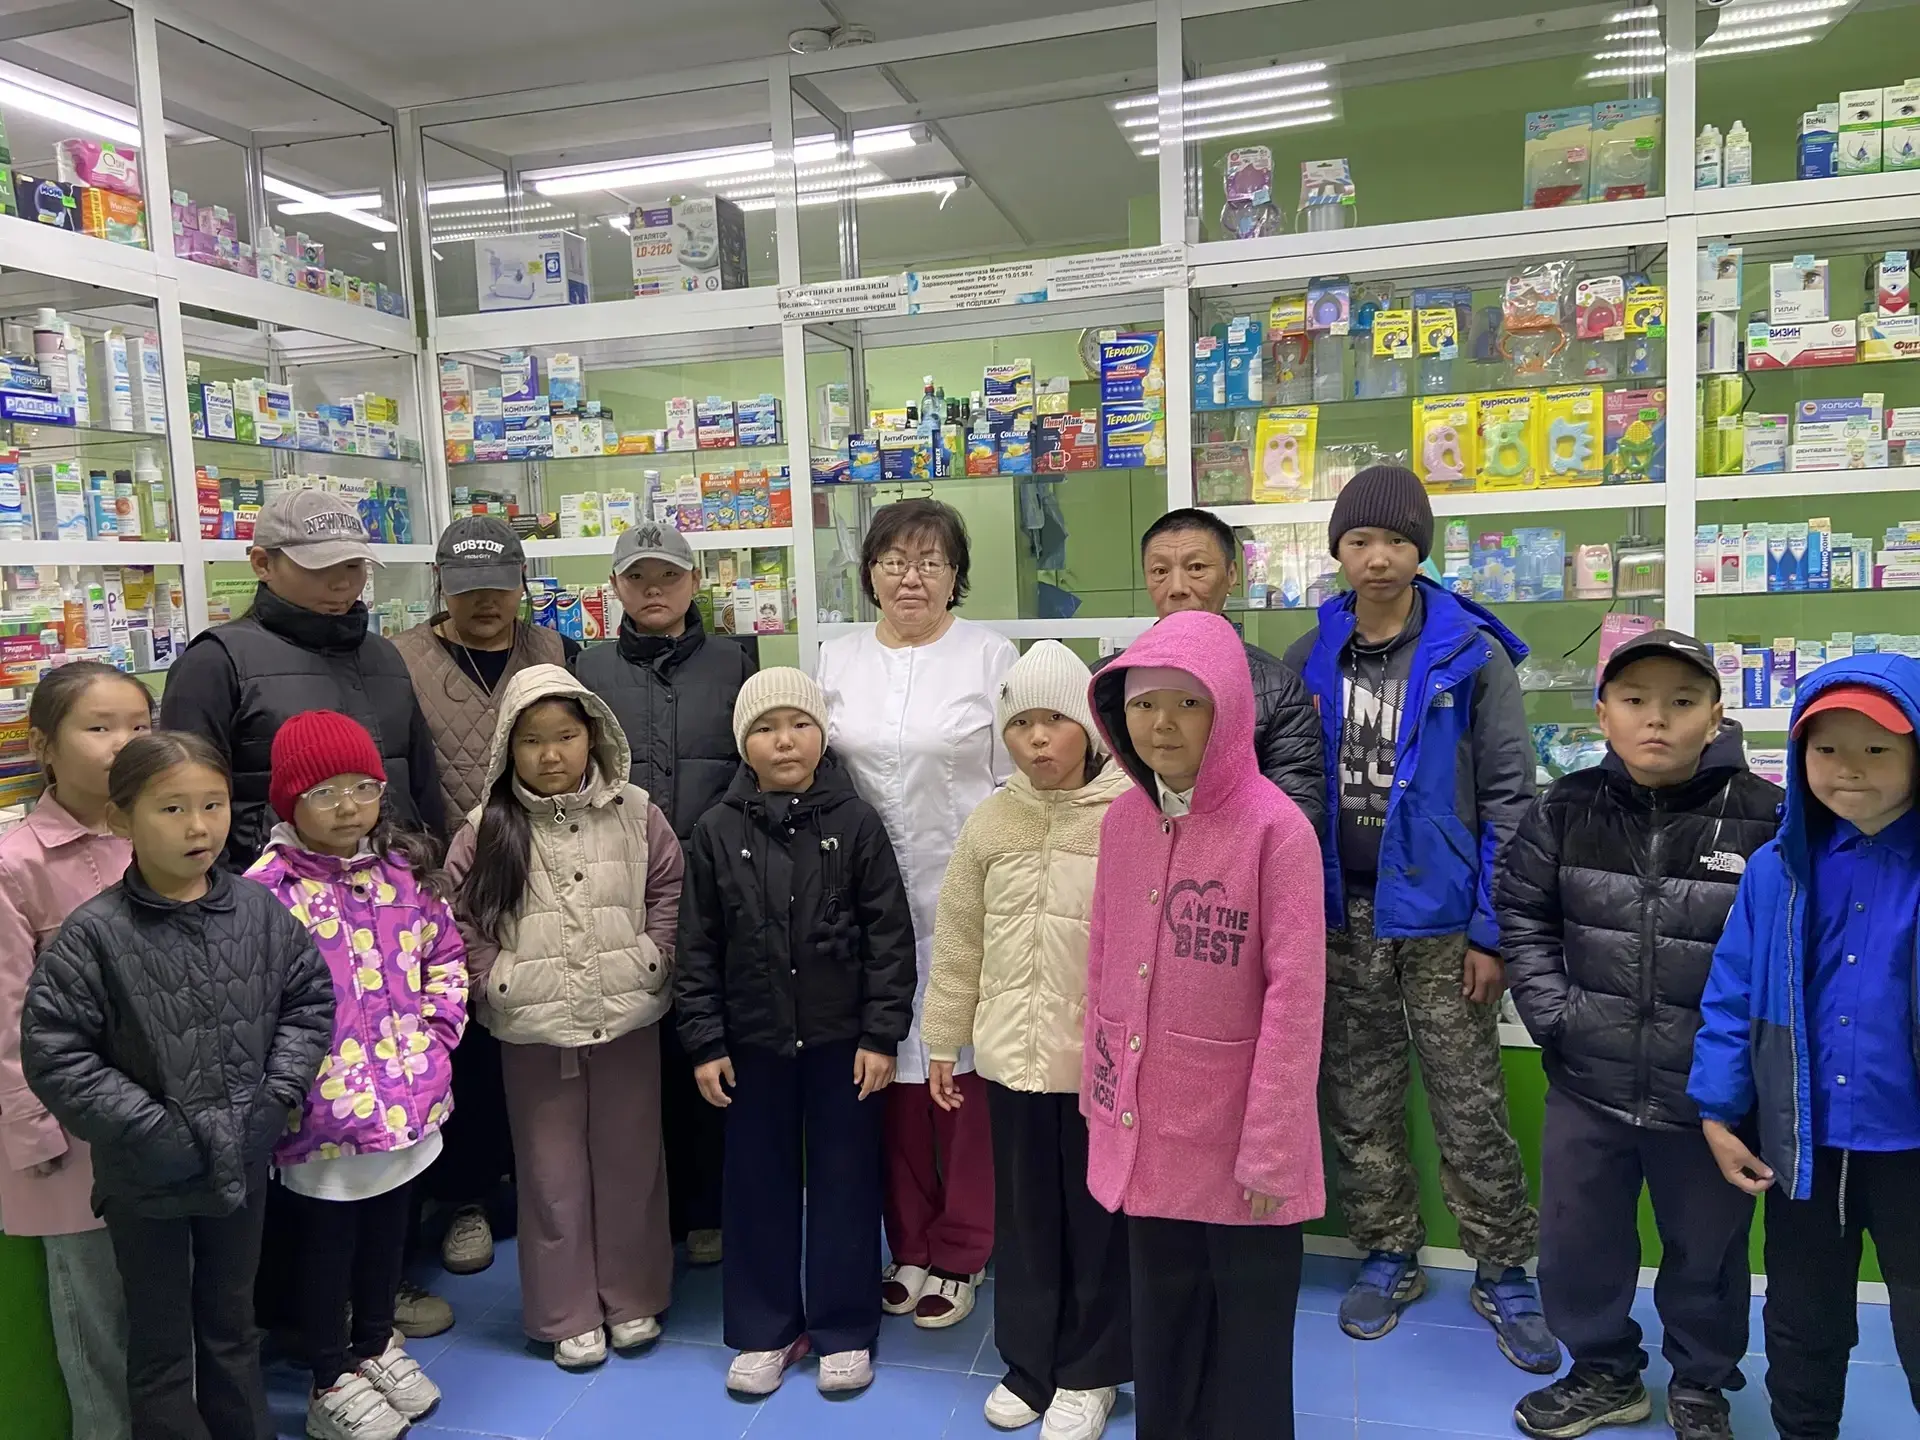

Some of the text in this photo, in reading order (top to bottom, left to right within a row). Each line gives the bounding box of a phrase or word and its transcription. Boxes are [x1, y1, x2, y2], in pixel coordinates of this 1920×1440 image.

[633, 231, 668, 242] ИНГАЛЯТОР
[931, 272, 964, 280] основании
[965, 269, 989, 278] приказа
[989, 264, 1033, 274] Министерства
[1882, 265, 1906, 274] ВИЗИН
[844, 281, 889, 292] инвалиды
[922, 278, 975, 288] Здравоохранения
[977, 275, 987, 283] РФ
[957, 282, 999, 291] медикаменты
[872, 292, 897, 300] войны
[949, 291, 977, 299] возврату
[966, 298, 1001, 307] ПОДЛЕЖАТ
[783, 308, 843, 319] обслуживаются
[863, 302, 896, 312] очереди
[1774, 305, 1800, 313] ГИЛАН
[1769, 328, 1800, 338] ВИЗИН
[1104, 344, 1149, 358] ТЕРАФЛЮ
[1546, 390, 1591, 401] Курносики
[1481, 395, 1530, 408] Курносики
[1821, 401, 1863, 410] ХОЛИСА
[1106, 412, 1151, 426] ТЕРАФЛЮ
[1001, 429, 1028, 438] COLDREX
[885, 471, 893, 479] 10
[705, 478, 732, 488] Мишки
[739, 477, 766, 487] Мишки
[304, 513, 335, 535] NEW
[452, 539, 505, 555] BOSTON
[4, 645, 33, 653] ТРИДЕРМ
[1750, 757, 1784, 765] Отривин
[1712, 850, 1727, 859] THE
[1707, 863, 1731, 872] FACE
[1215, 906, 1249, 931] THE
[1174, 923, 1245, 967] BEST
